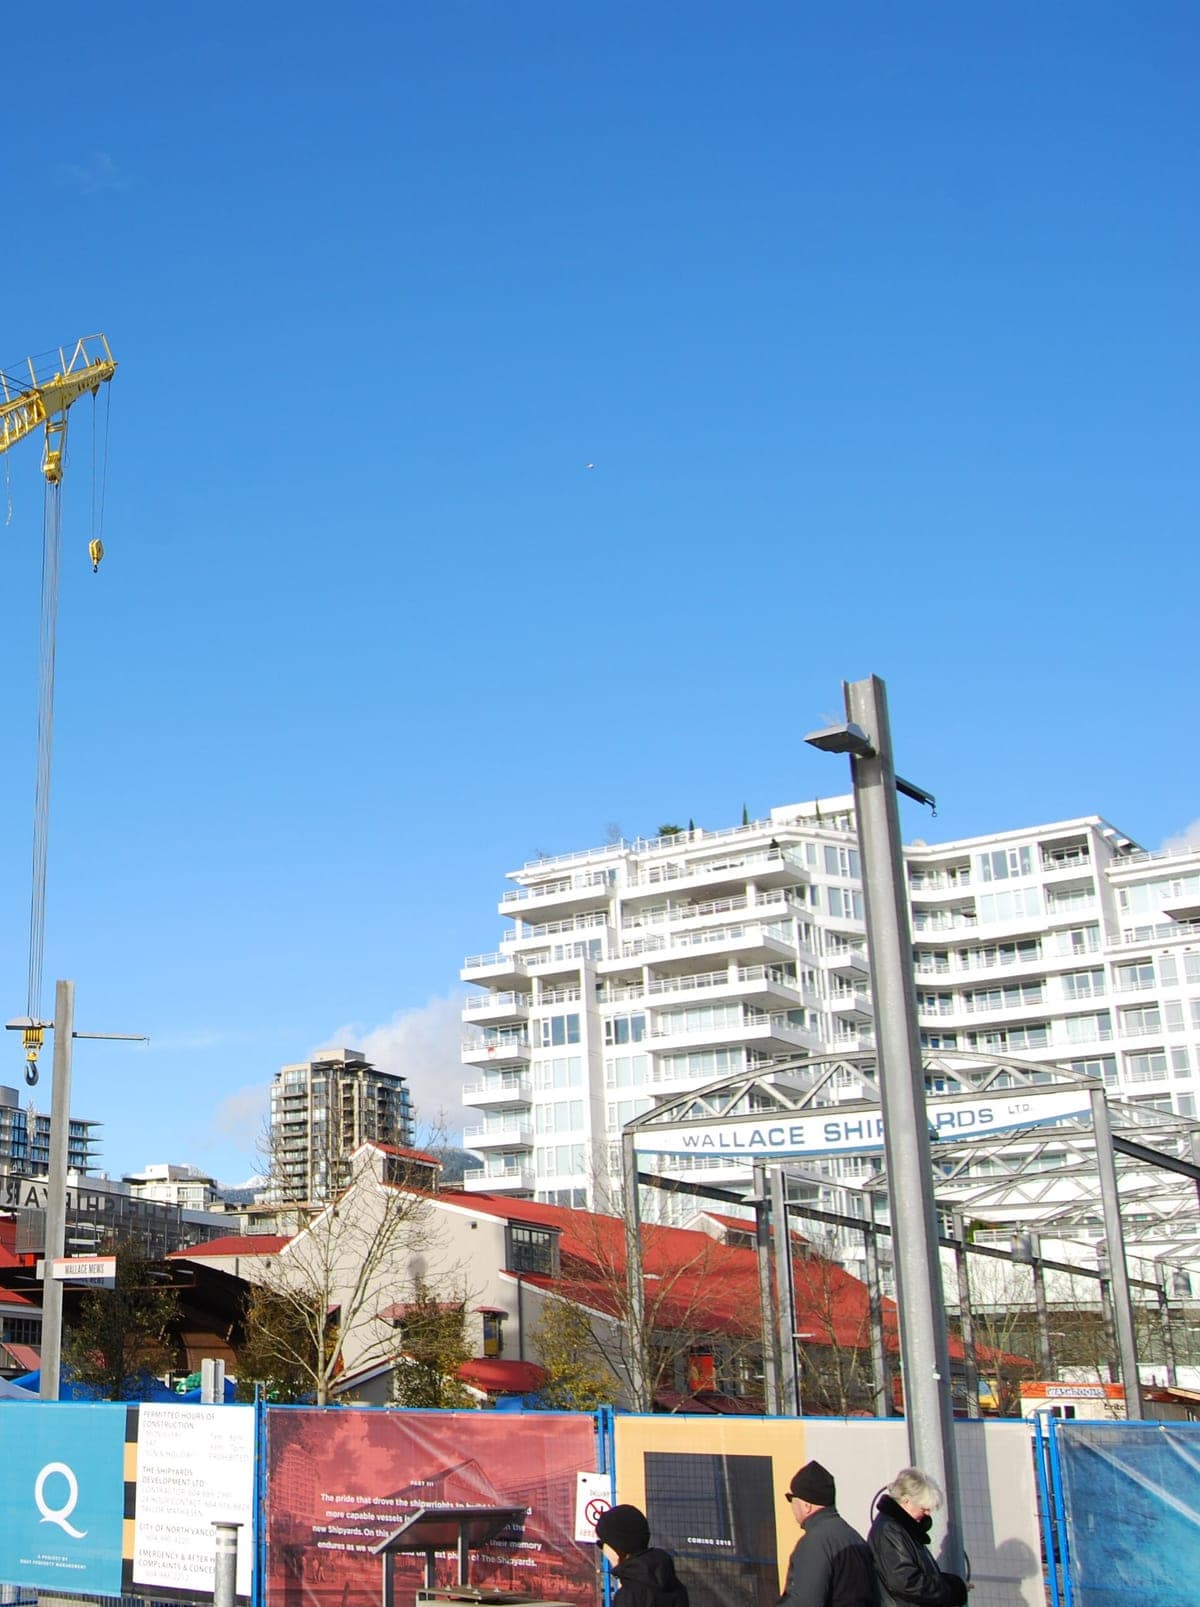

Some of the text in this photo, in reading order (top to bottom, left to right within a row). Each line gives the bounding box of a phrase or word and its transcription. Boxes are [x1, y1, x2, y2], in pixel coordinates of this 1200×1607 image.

[682, 1126, 805, 1148] WALLACE
[65, 1263, 104, 1274] WALLACE MEWS
[143, 1410, 215, 1420] PERMITTED HOURS OF
[143, 1420, 194, 1430] CONSTRUCTION
[157, 1467, 193, 1476] SHIPYARDS
[142, 1476, 190, 1486] DEVELOPMENT
[35, 1462, 88, 1538] Q
[320, 1493, 334, 1502] The
[335, 1495, 355, 1503] pride
[356, 1496, 372, 1504] that
[373, 1497, 394, 1506] drove
[395, 1498, 408, 1506] the
[410, 1499, 454, 1508] shipwrights
[325, 1510, 344, 1519] more
[346, 1511, 375, 1521] capable
[376, 1513, 403, 1522] vessels
[139, 1522, 216, 1537] CITY OF NORTH VANCO
[328, 1525, 363, 1536] Shipyards.
[363, 1528, 374, 1537] On
[375, 1528, 389, 1537] this
[510, 1541, 542, 1551] memory
[139, 1548, 178, 1560] EMERGENCY
[180, 1553, 185, 1561] &
[187, 1554, 209, 1563] AFTER
[317, 1542, 345, 1551] endures
[346, 1543, 355, 1551] as
[355, 1544, 366, 1552] we
[434, 1551, 446, 1559] ext
[138, 1558, 181, 1570] COMPLAINTS
[189, 1564, 215, 1574] CONCE
